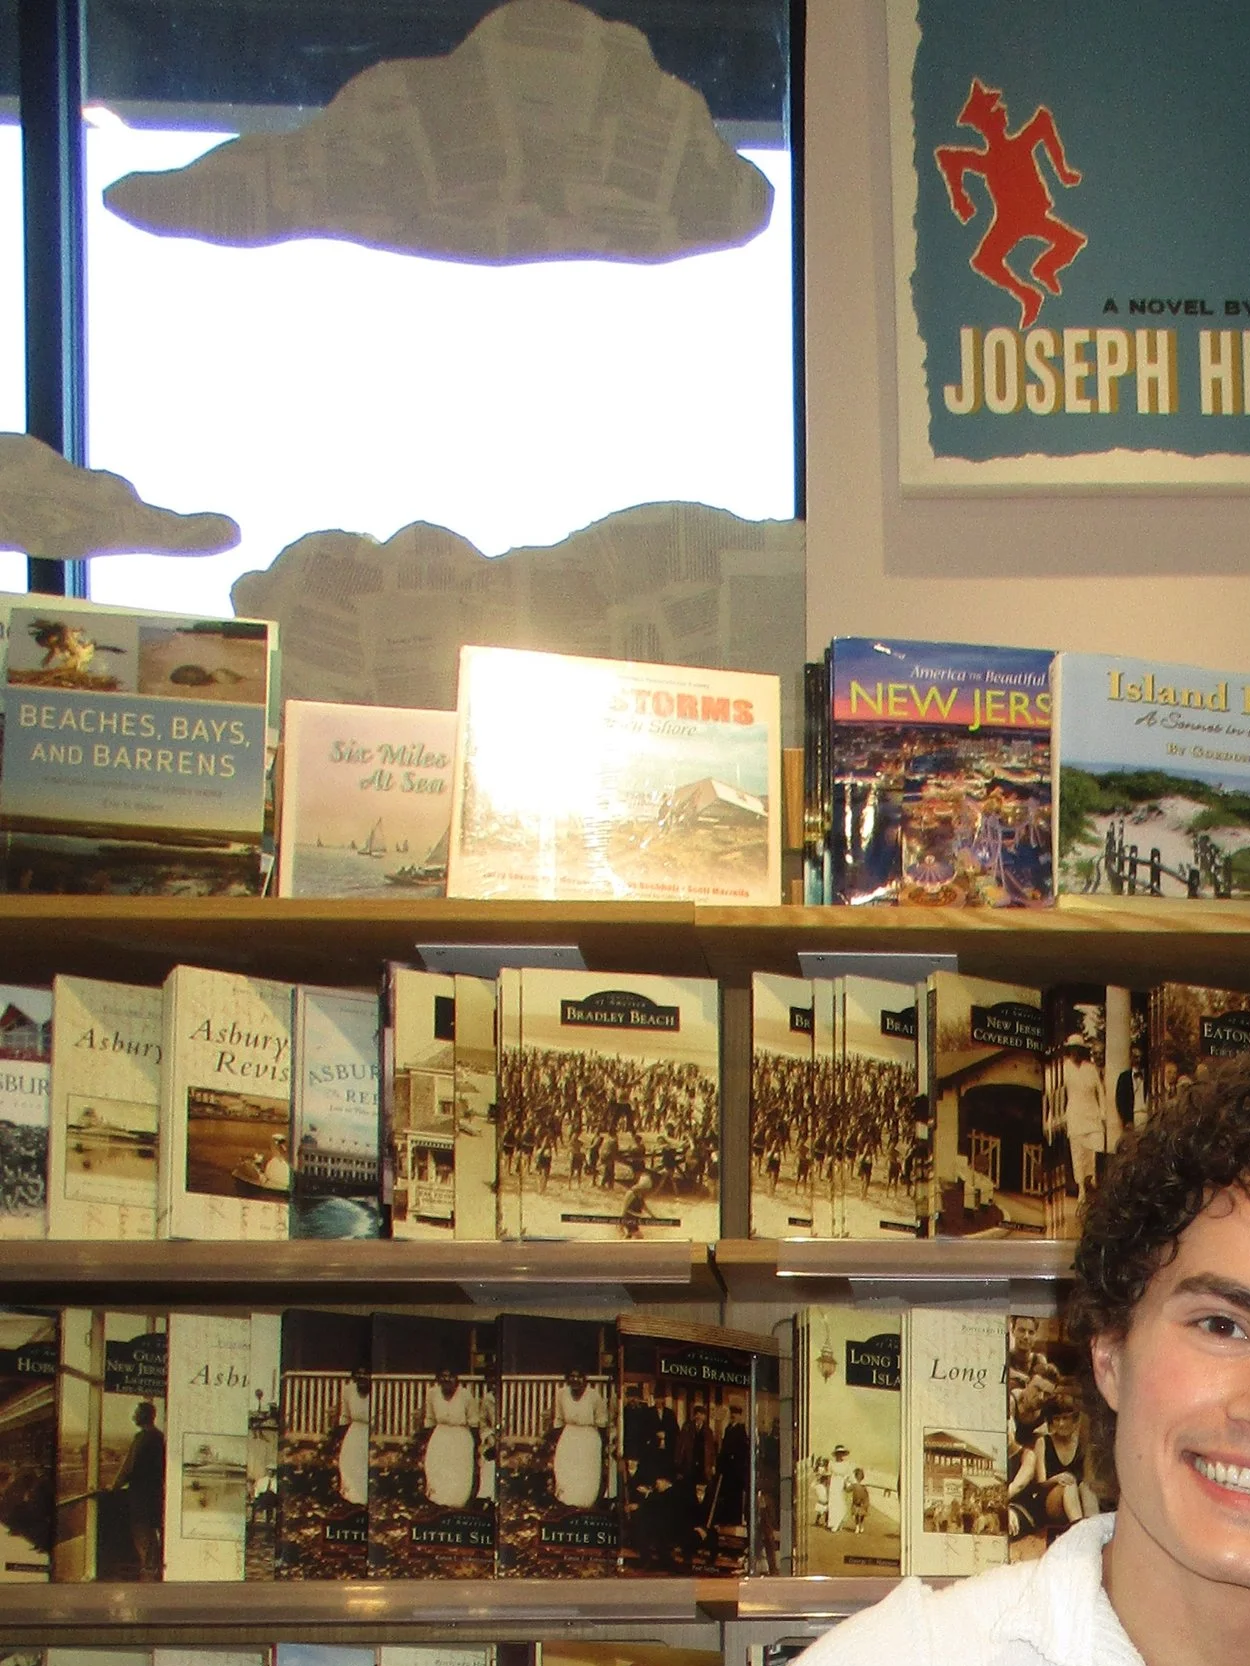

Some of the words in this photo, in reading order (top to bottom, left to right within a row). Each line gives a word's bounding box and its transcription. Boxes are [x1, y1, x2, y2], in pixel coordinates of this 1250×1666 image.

[1103, 298, 1118, 314] A
[1129, 298, 1214, 316] NOVEL
[943, 326, 1178, 415] JOSEPH
[910, 665, 967, 682] America
[985, 669, 1047, 687] Beautiful
[849, 680, 958, 720] NEW
[1106, 669, 1230, 714] Island
[19, 703, 162, 742] BEACHES,
[171, 716, 251, 749] BAYS,
[29, 743, 83, 766] AND
[92, 744, 237, 779] BARRENS
[329, 738, 373, 765] Six
[376, 741, 449, 769] Miles
[359, 768, 395, 793] At
[400, 771, 447, 795] Sea
[566, 1005, 626, 1023] BRADLEY
[629, 1008, 676, 1027] BEACH
[190, 1018, 289, 1063] Asbury
[973, 1027, 1023, 1048] COVERED
[661, 1359, 697, 1377] LONG
[702, 1365, 752, 1386] BRANCH
[850, 1349, 891, 1369] LONG
[929, 1357, 988, 1390] Long
[411, 1527, 463, 1544] LITTLE
[541, 1527, 590, 1544] LITTLE
